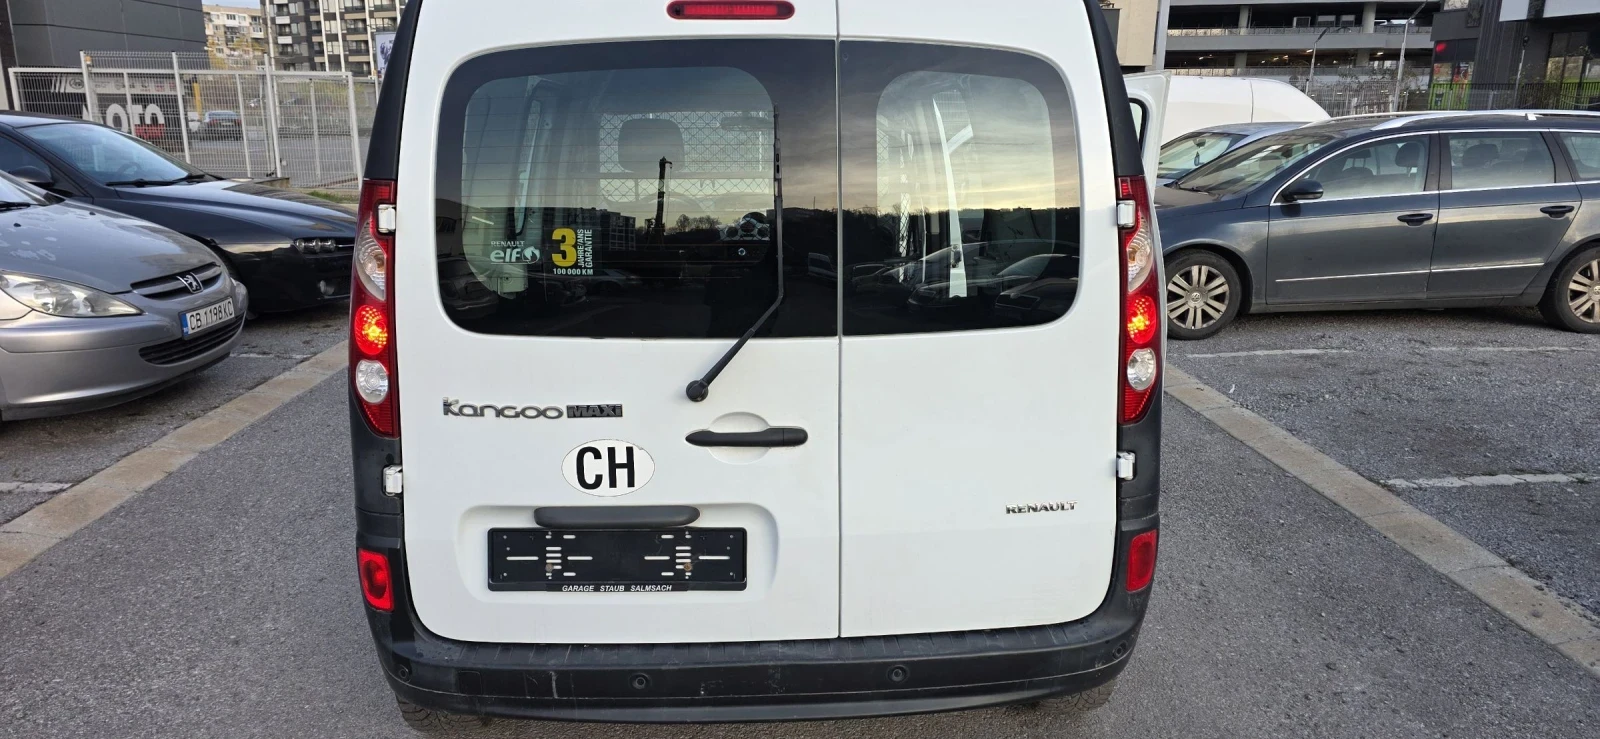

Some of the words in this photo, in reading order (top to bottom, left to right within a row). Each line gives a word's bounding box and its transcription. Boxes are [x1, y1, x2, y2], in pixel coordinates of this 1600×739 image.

[490, 248, 521, 262] elf
[552, 228, 577, 267] 3
[585, 229, 593, 268] GARANTIE
[189, 312, 202, 331] CB
[576, 446, 635, 490] CH
[1005, 501, 1077, 514] RENAULT
[562, 584, 594, 592] GARAGE
[600, 584, 625, 592] STAUB
[630, 584, 672, 592] SALMSACH
